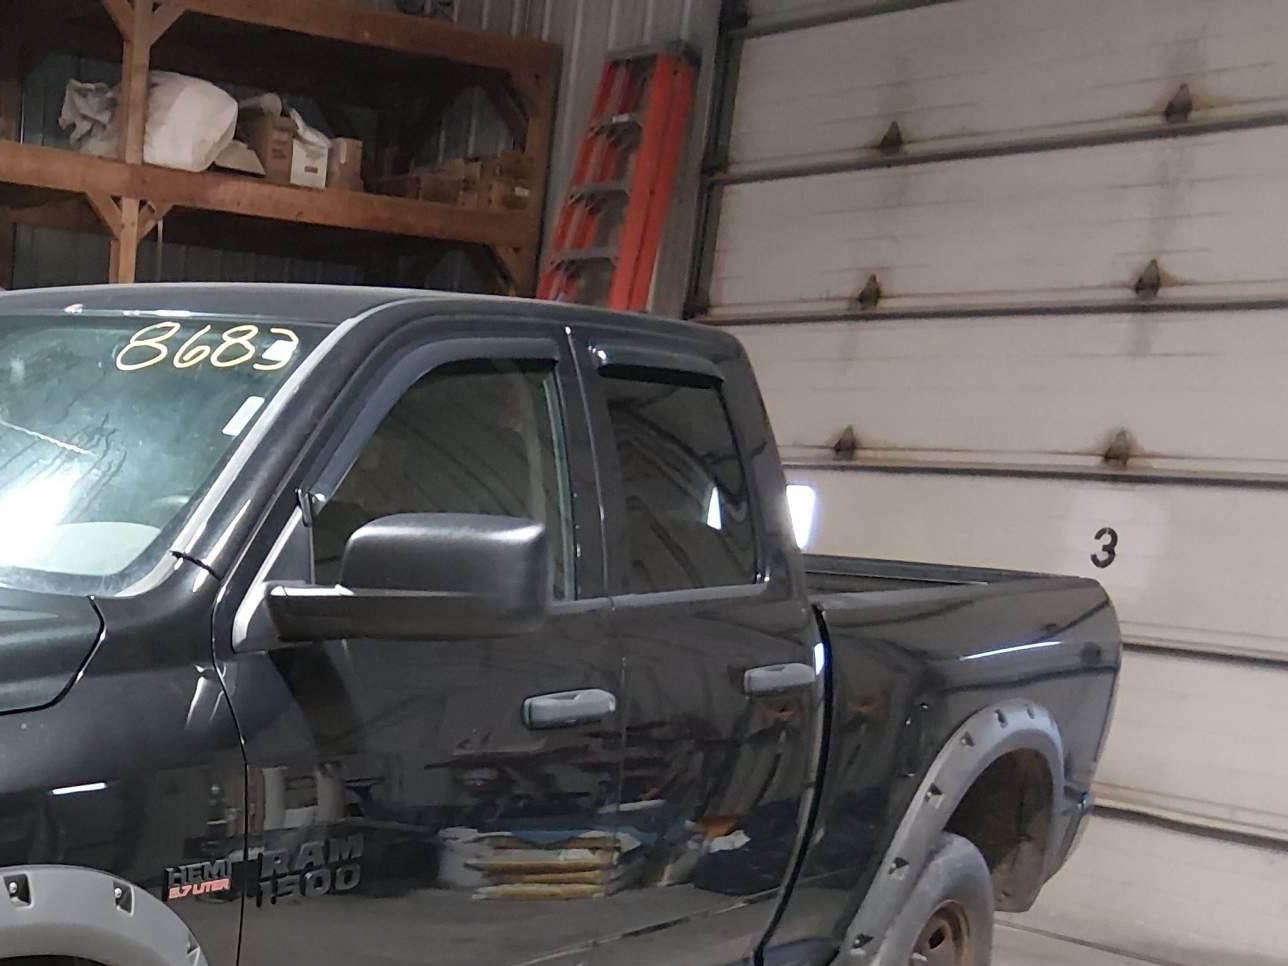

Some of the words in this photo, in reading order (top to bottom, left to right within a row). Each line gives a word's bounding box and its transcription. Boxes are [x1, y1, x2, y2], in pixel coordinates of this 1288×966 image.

[115, 321, 300, 371] 8683
[1090, 526, 1118, 569] 3
[165, 858, 233, 888] HEMI
[258, 836, 362, 877] RAM
[192, 878, 231, 896] LITER
[257, 863, 362, 902] 1500
